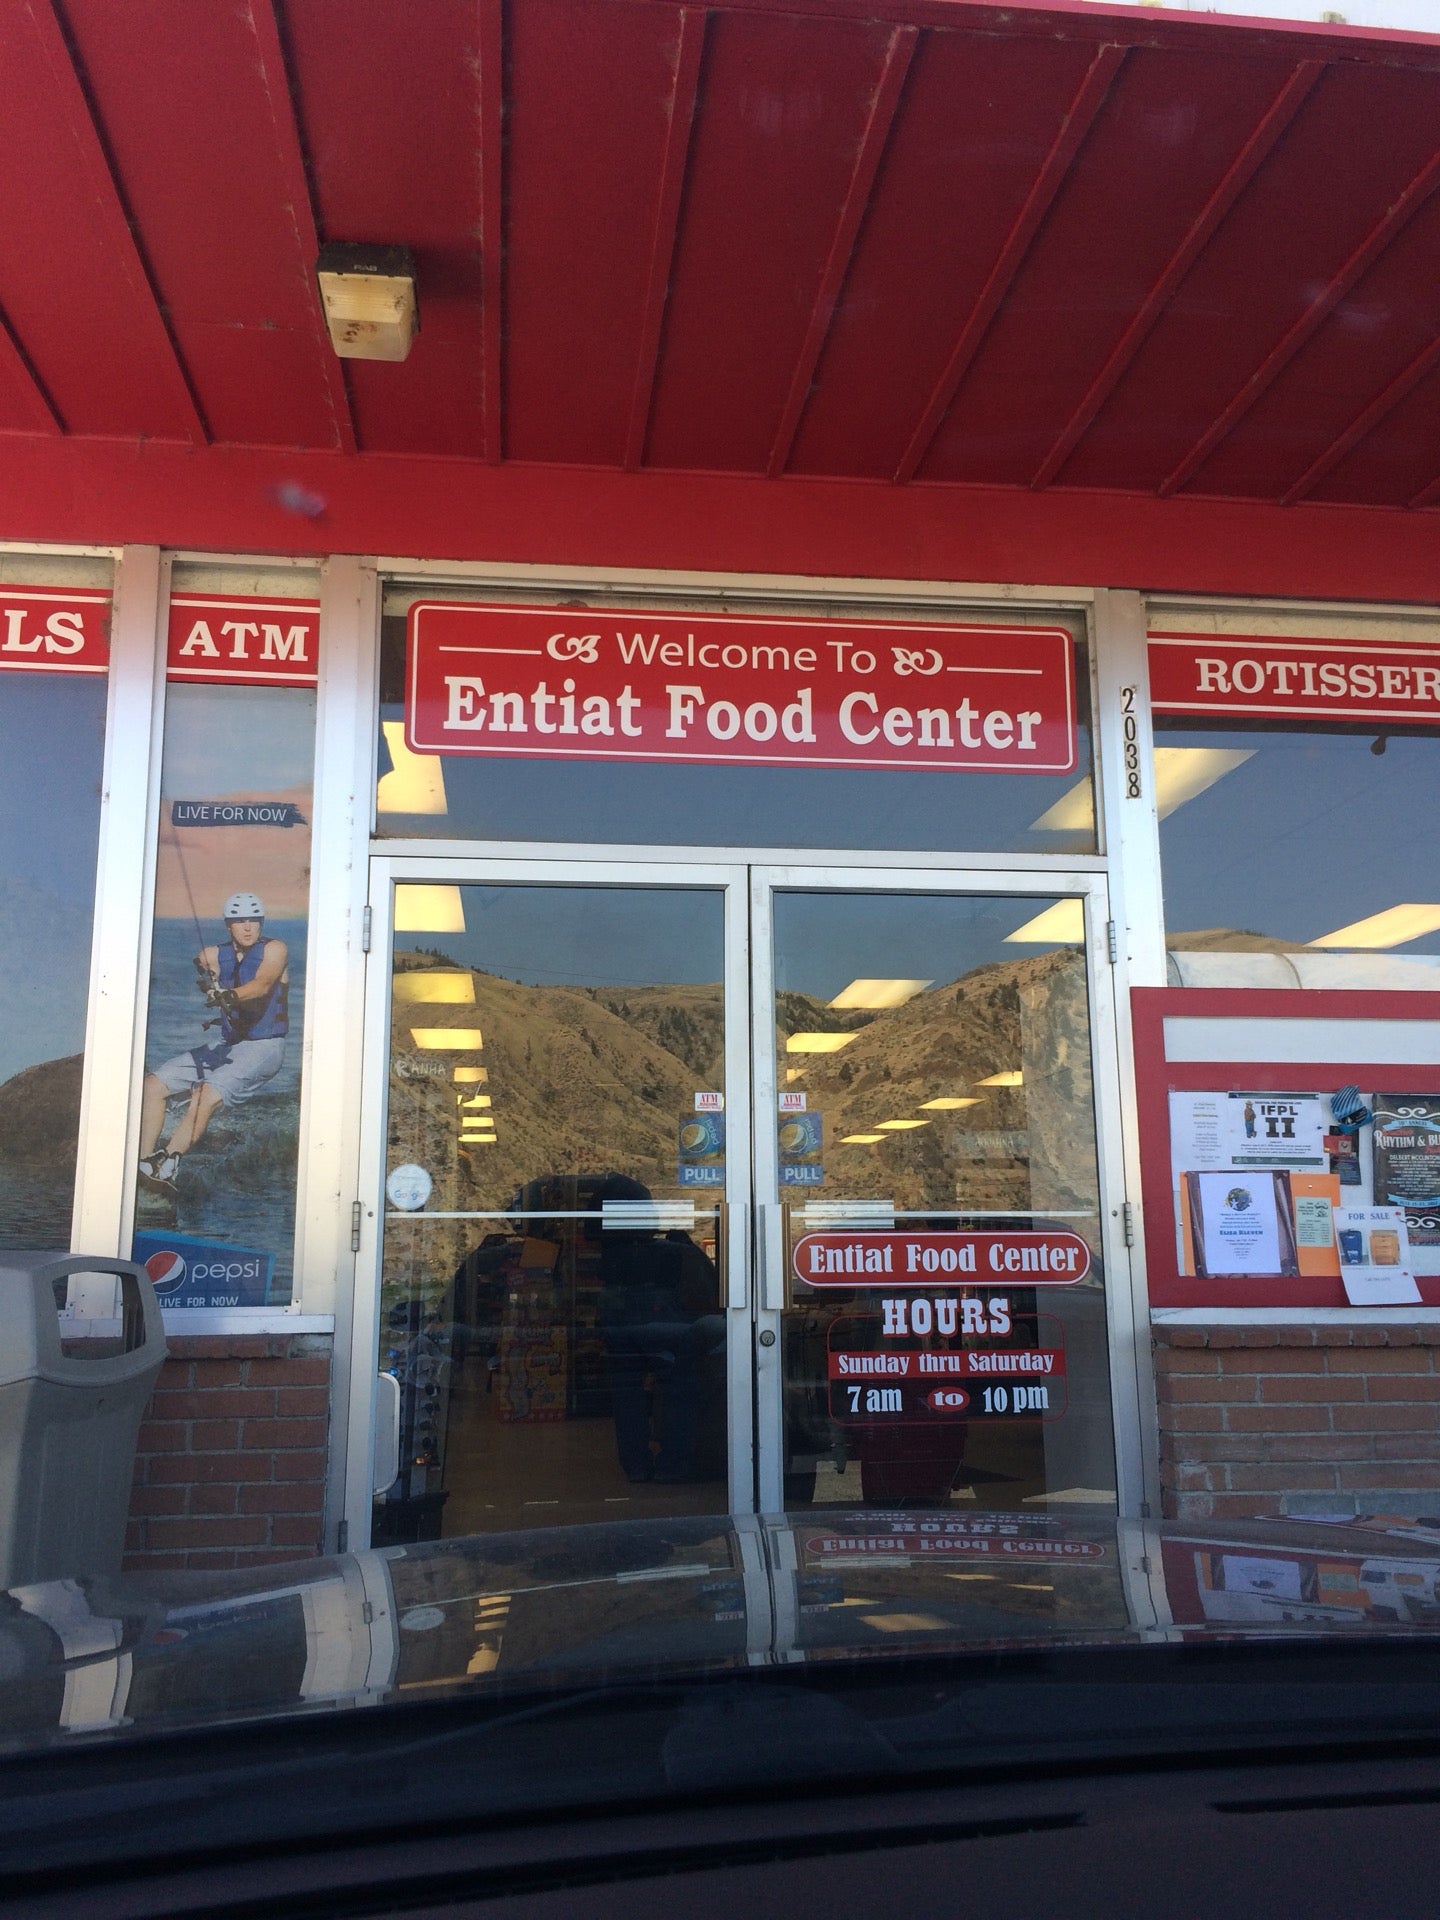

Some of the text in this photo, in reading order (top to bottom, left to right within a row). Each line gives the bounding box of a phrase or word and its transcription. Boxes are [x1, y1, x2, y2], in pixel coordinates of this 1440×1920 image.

[1, 609, 85, 655] LS
[178, 620, 310, 662] ATM
[616, 632, 877, 674] Welcome To
[1194, 657, 1440, 702] ROTISSER
[443, 675, 1042, 750] Entiat Food Center
[1121, 687, 1141, 799] 2038
[177, 805, 288, 822] LIVE FOR NOW
[1260, 1105, 1299, 1116] IFPL
[704, 1118, 720, 1145] pepsi
[804, 1117, 818, 1145] pepsi
[1265, 1117, 1296, 1138] II
[1373, 1130, 1415, 1150] RHYTHM
[1417, 1135, 1426, 1147] &
[684, 1167, 721, 1181] PULL
[784, 1167, 820, 1181] PULL
[1348, 1212, 1391, 1220] FOR SALE
[808, 1242, 1080, 1274] Entiat Food Center
[191, 1259, 260, 1284] pepsi
[159, 1296, 239, 1308] LIVE FOR NOW
[882, 1297, 1012, 1336] HOURS
[837, 1352, 1055, 1375] Sunday thru Saturday
[932, 1390, 964, 1406] to
